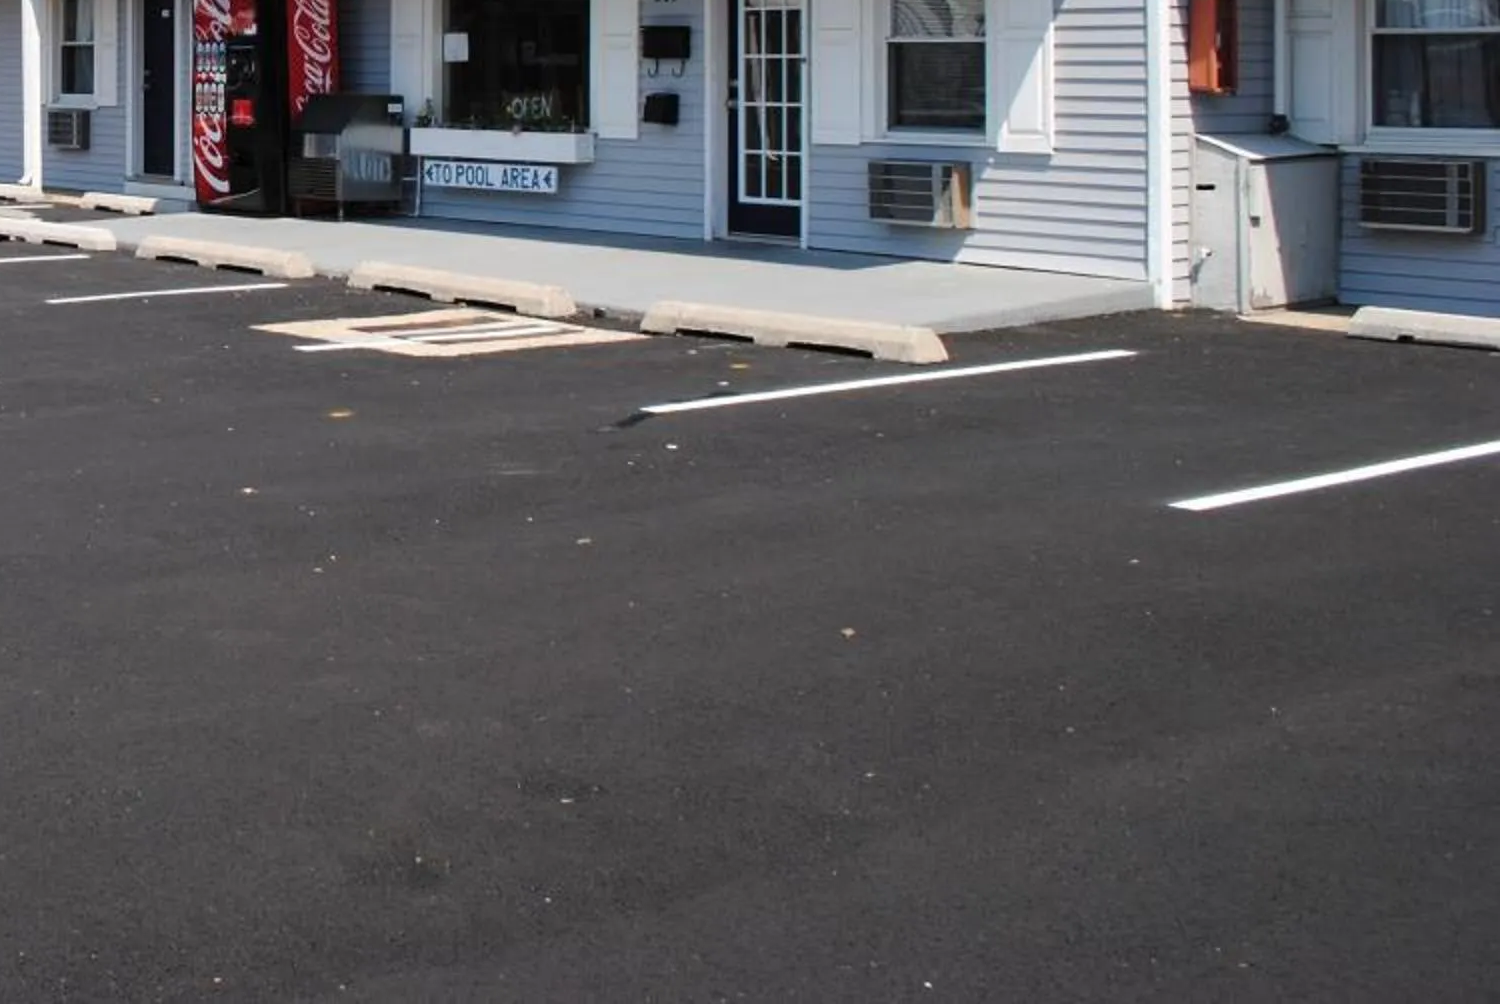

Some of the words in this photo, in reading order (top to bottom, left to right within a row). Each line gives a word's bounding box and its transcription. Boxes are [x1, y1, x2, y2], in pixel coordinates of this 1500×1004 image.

[511, 94, 551, 119] OPEN
[433, 163, 452, 184] TO
[455, 164, 495, 187] POOL
[501, 166, 541, 189] AREA
